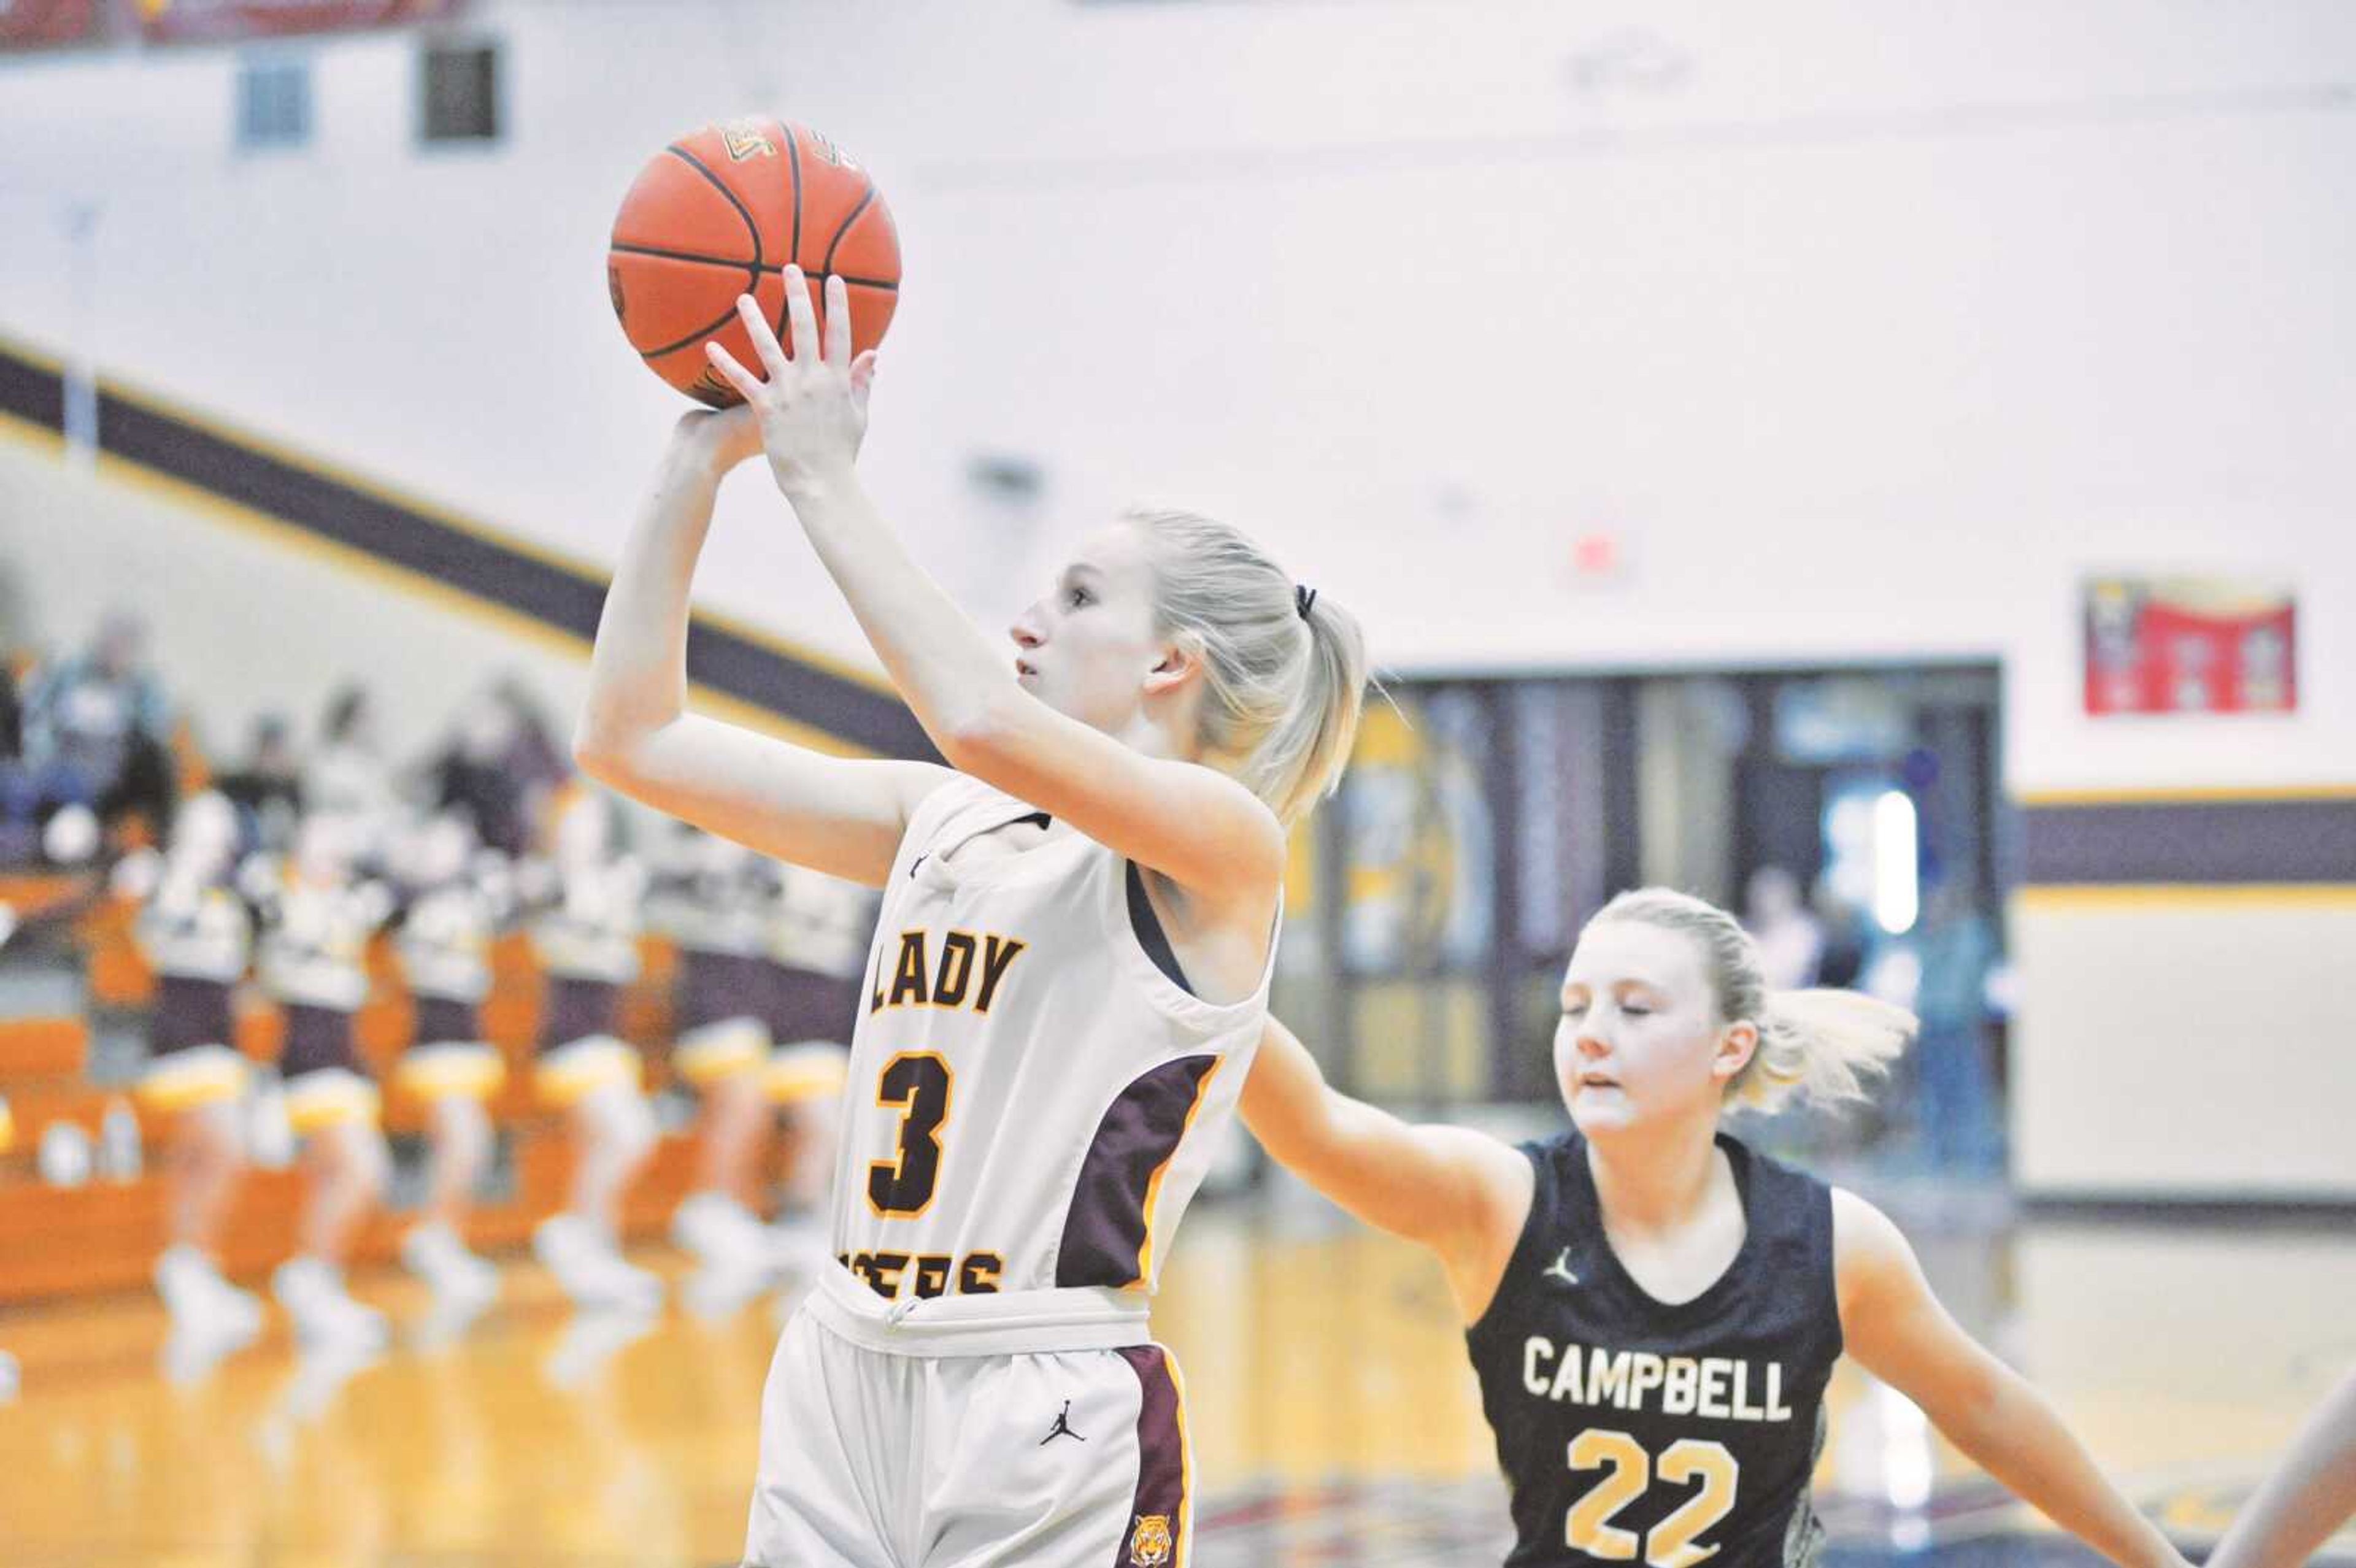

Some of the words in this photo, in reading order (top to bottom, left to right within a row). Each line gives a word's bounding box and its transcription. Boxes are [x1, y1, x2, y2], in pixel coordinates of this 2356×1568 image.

[870, 930, 1026, 1014] LADY
[867, 1050, 955, 1218] 3
[1523, 1336, 1792, 1421] CAMPBELL
[1566, 1429, 1739, 1568] 22
